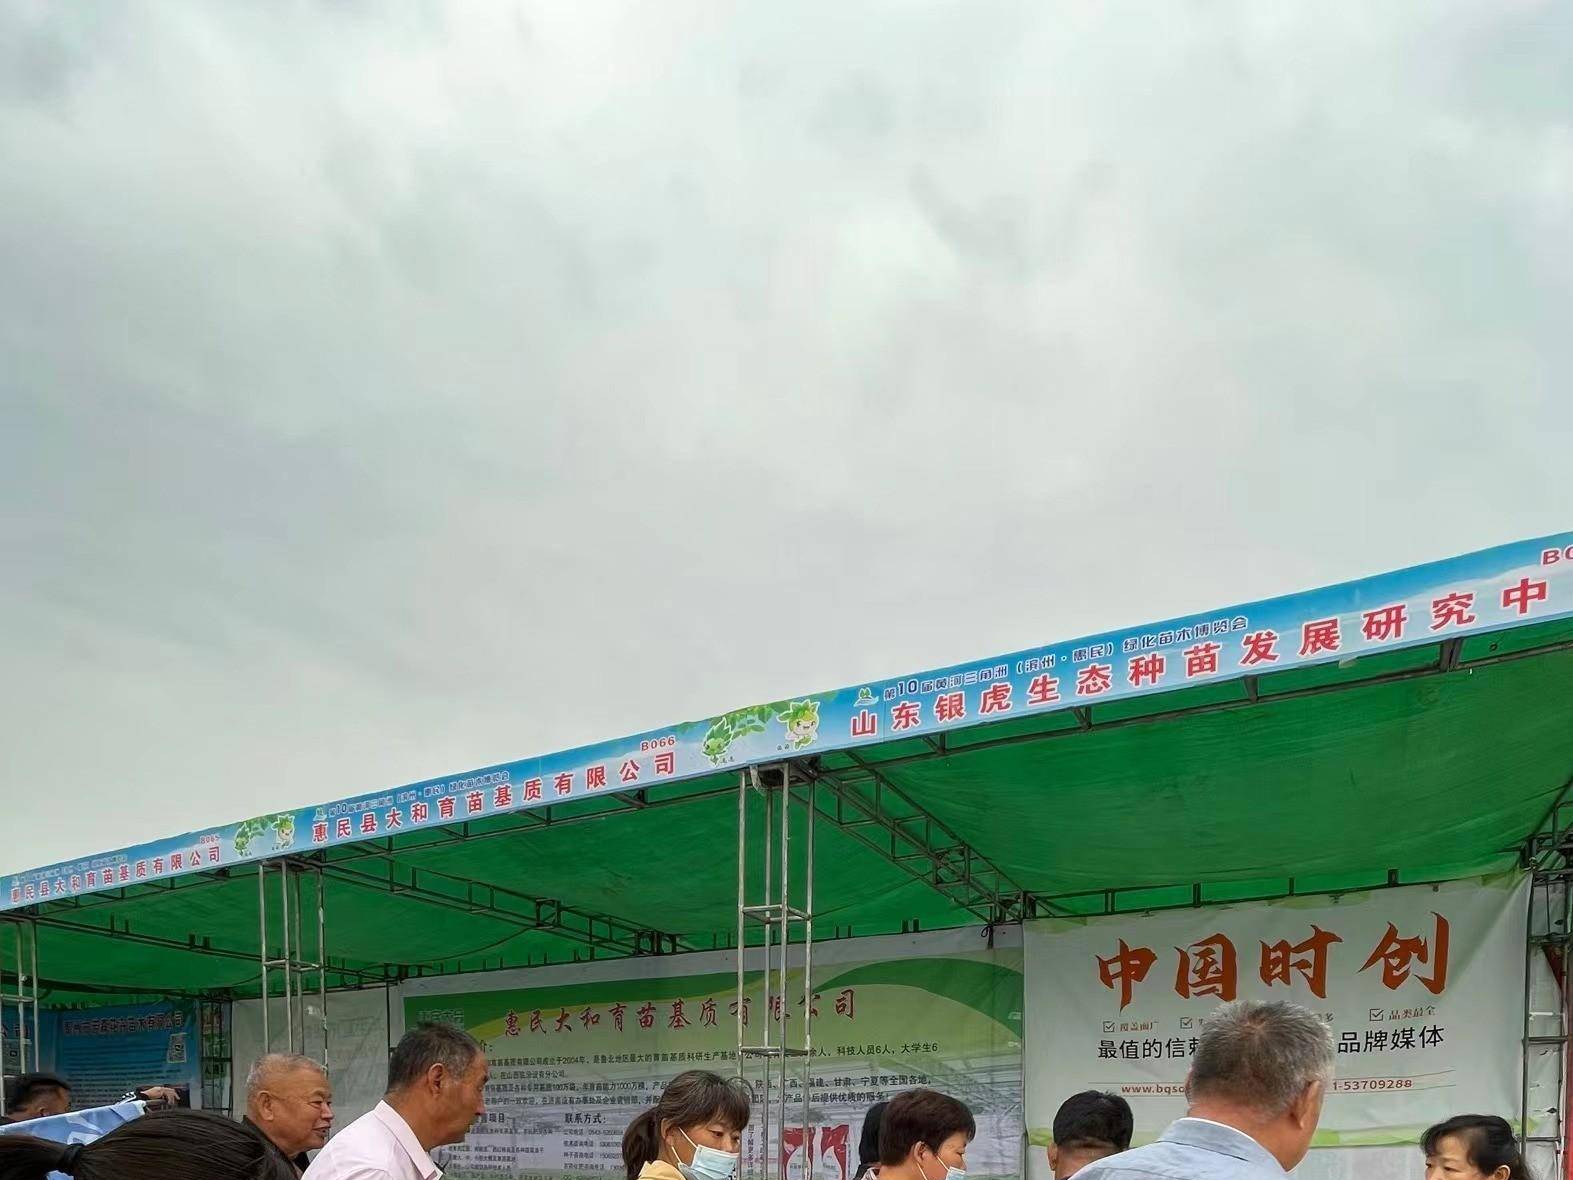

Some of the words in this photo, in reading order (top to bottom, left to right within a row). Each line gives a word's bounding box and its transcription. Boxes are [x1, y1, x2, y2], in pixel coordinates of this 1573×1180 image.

[851, 577, 1547, 737] 山东银虎生态种苗发展研究中
[640, 735, 677, 752] B066
[313, 751, 676, 843] 惠民县大和育苗基质有限公司
[11, 846, 220, 903] 惠民县大和育苗基质有限公司
[1096, 911, 1452, 1011] 中国时创
[1337, 1024, 1445, 1054] 品牌媒体
